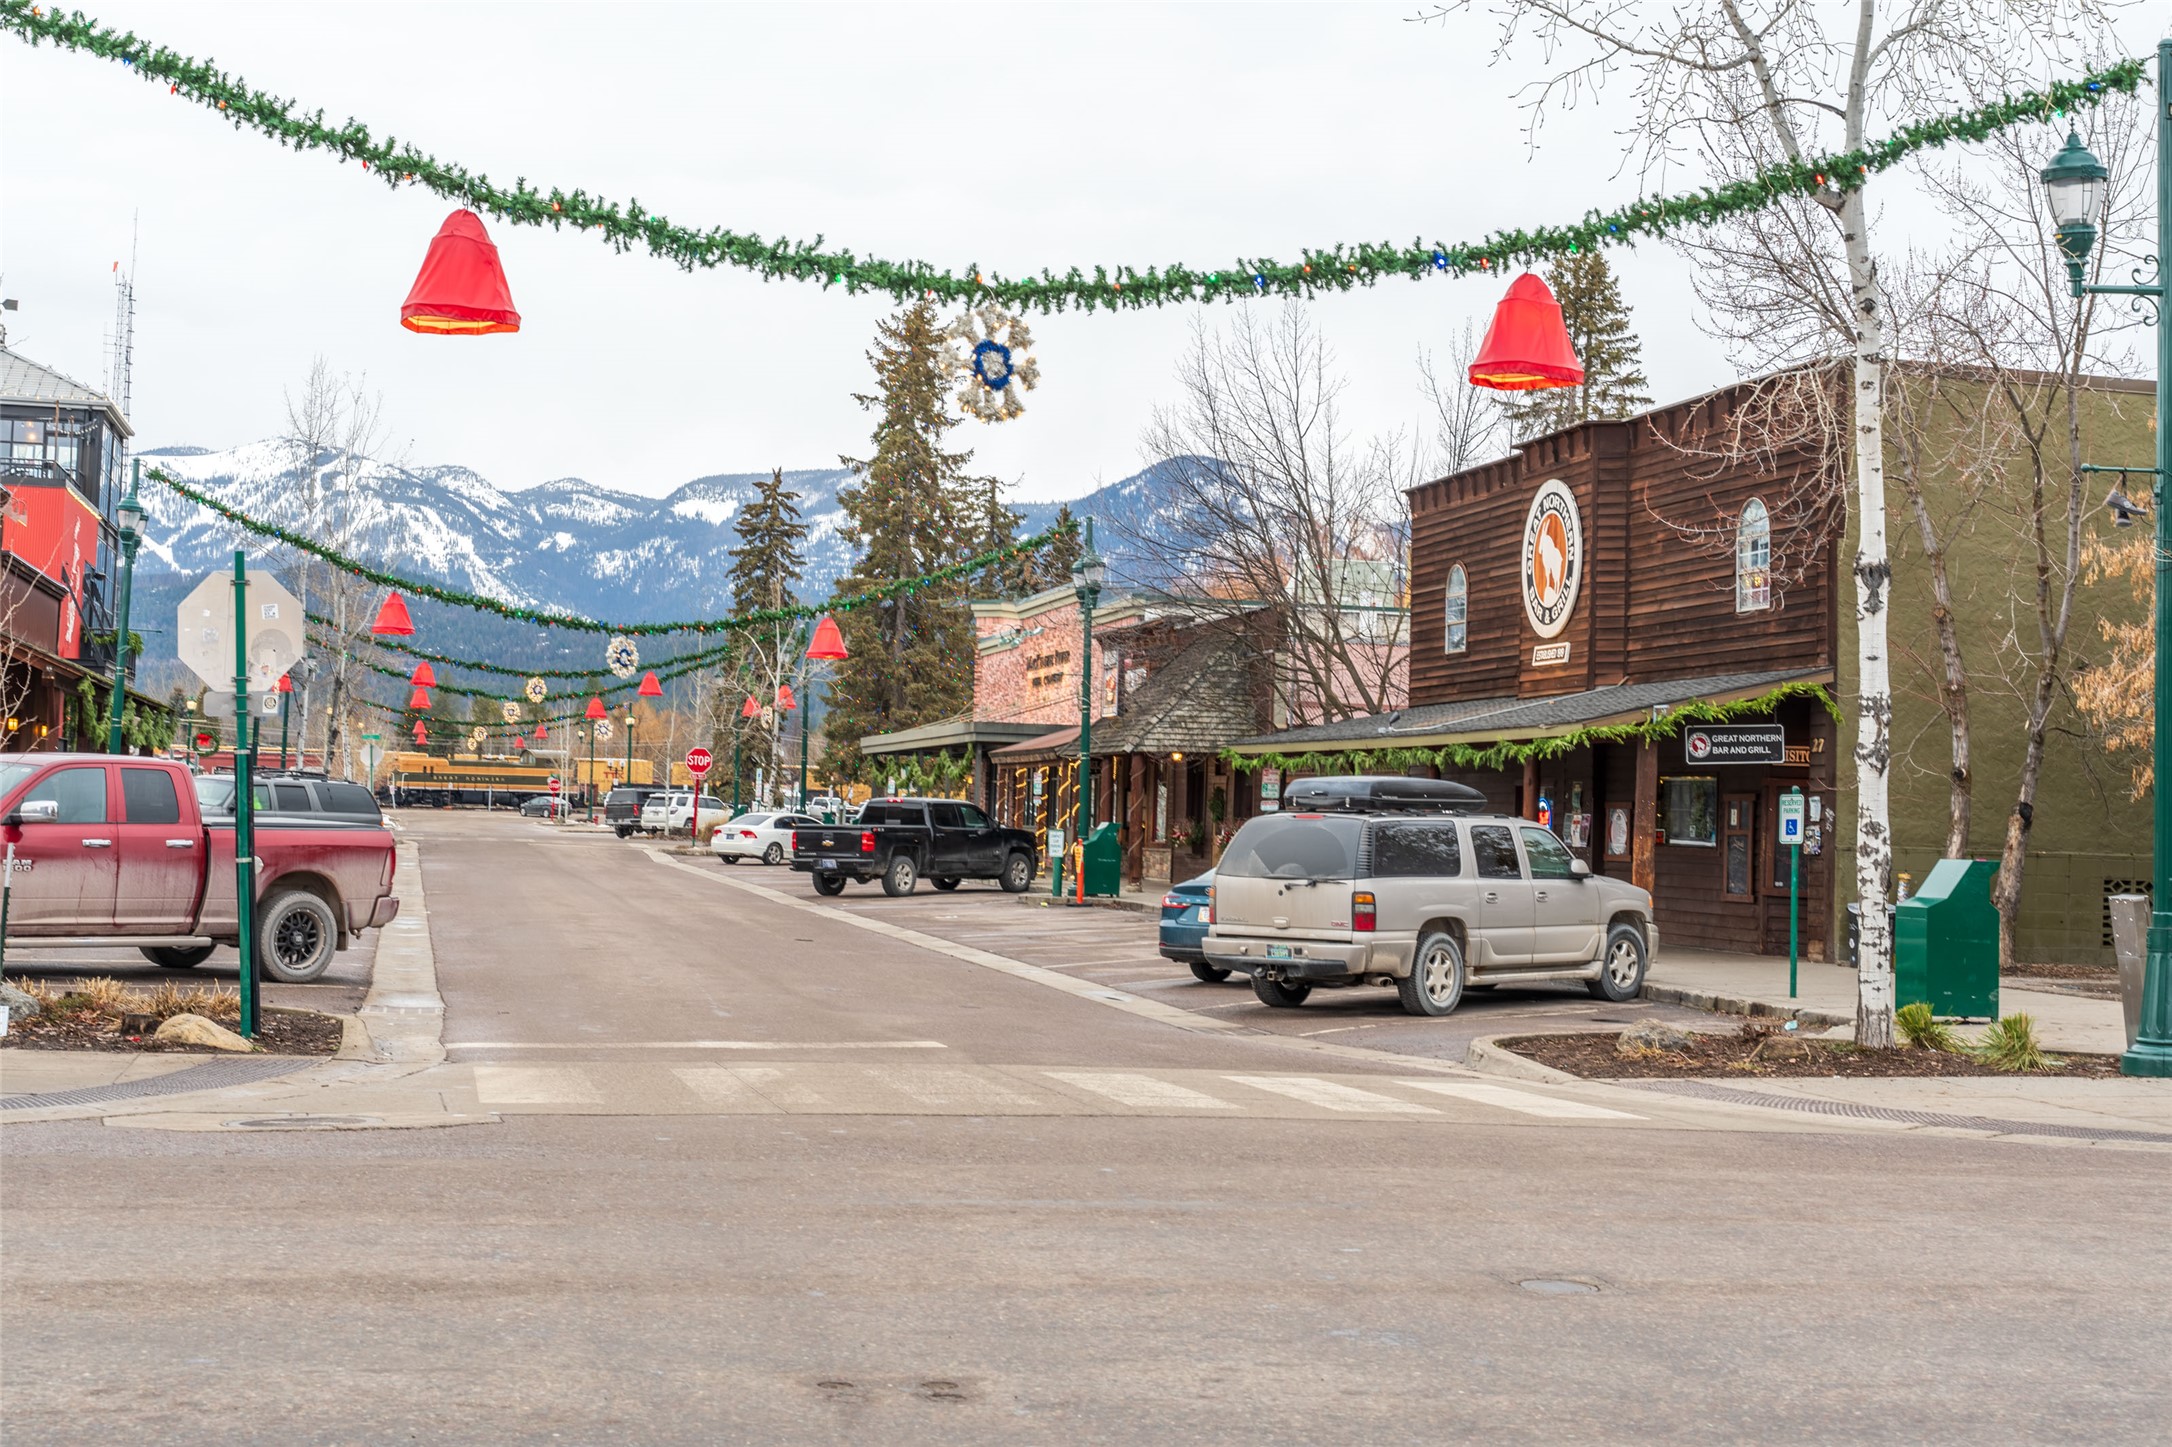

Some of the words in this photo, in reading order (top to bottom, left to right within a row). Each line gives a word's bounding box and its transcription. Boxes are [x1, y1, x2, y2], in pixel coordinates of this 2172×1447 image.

[1527, 506, 1541, 575] GREAT
[1543, 494, 1574, 562] NORTHERN
[1529, 585, 1543, 620] BAR
[1544, 609, 1550, 624] &
[1551, 576, 1572, 620] GRILL
[1712, 734, 1738, 743] GREAT
[1739, 733, 1782, 743] NORTHERN
[1712, 746, 1730, 754] BAR
[1730, 746, 1747, 754] AND
[1747, 745, 1771, 754] GRILL
[1812, 738, 1825, 753] 27
[687, 755, 711, 766] STOP
